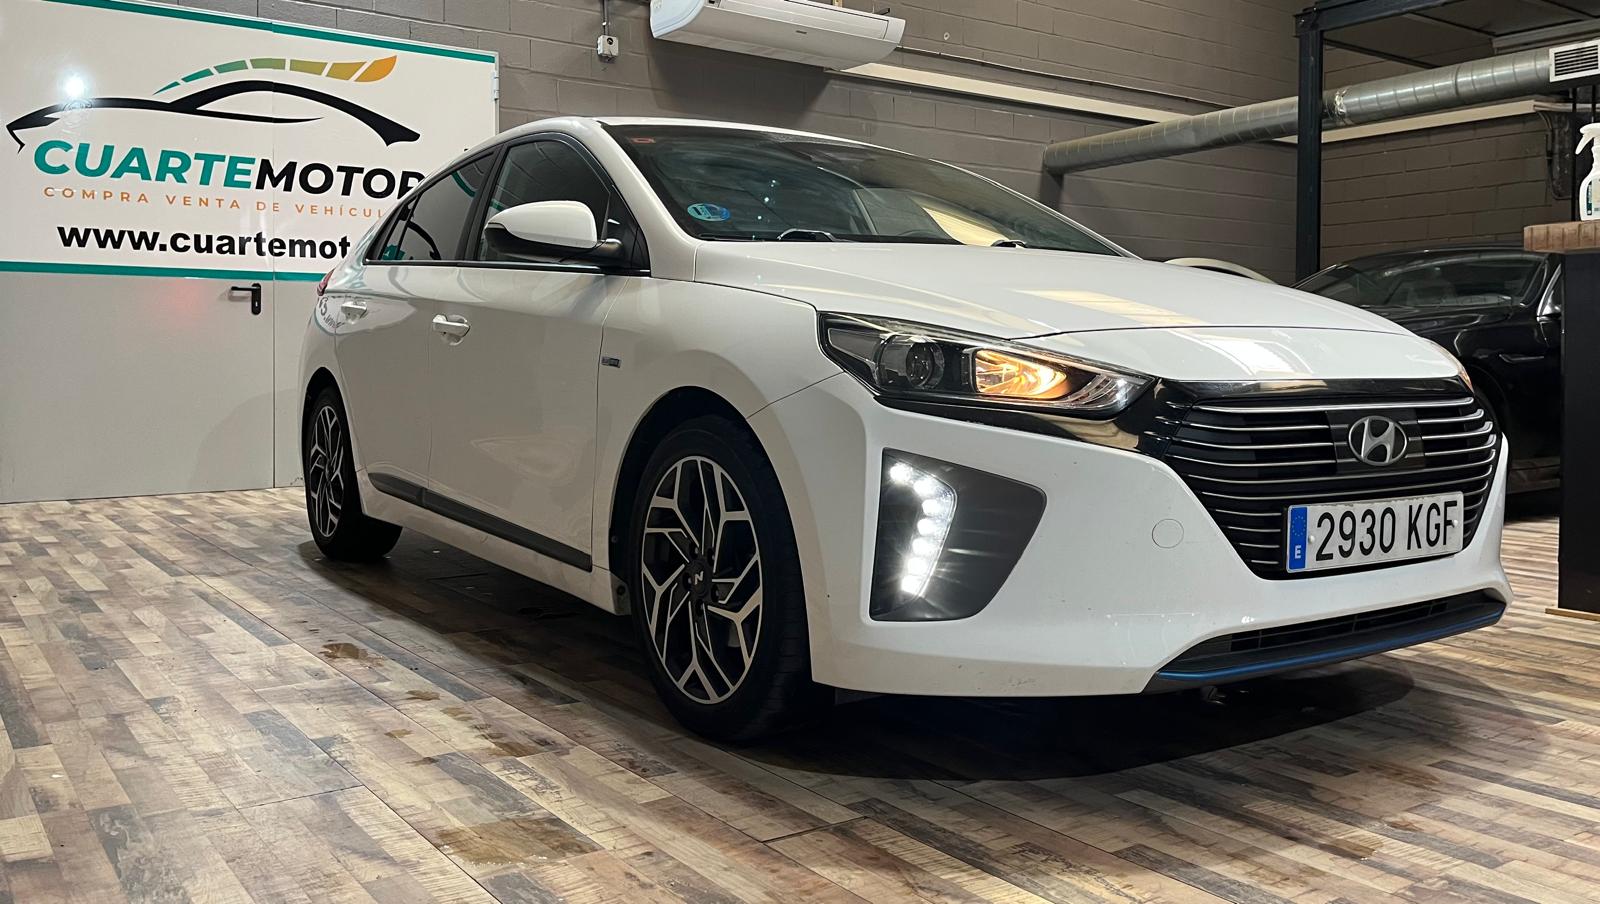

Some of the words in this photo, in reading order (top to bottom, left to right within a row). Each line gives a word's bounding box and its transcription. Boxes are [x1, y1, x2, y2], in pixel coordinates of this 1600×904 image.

[43, 186, 149, 204] COMPRA
[165, 194, 241, 210] VENTA
[256, 201, 280, 212] DE
[56, 226, 351, 260] www.cuartemot
[1315, 506, 1397, 562] 2930
[1407, 500, 1458, 550] KGF
[1294, 544, 1302, 559] E
